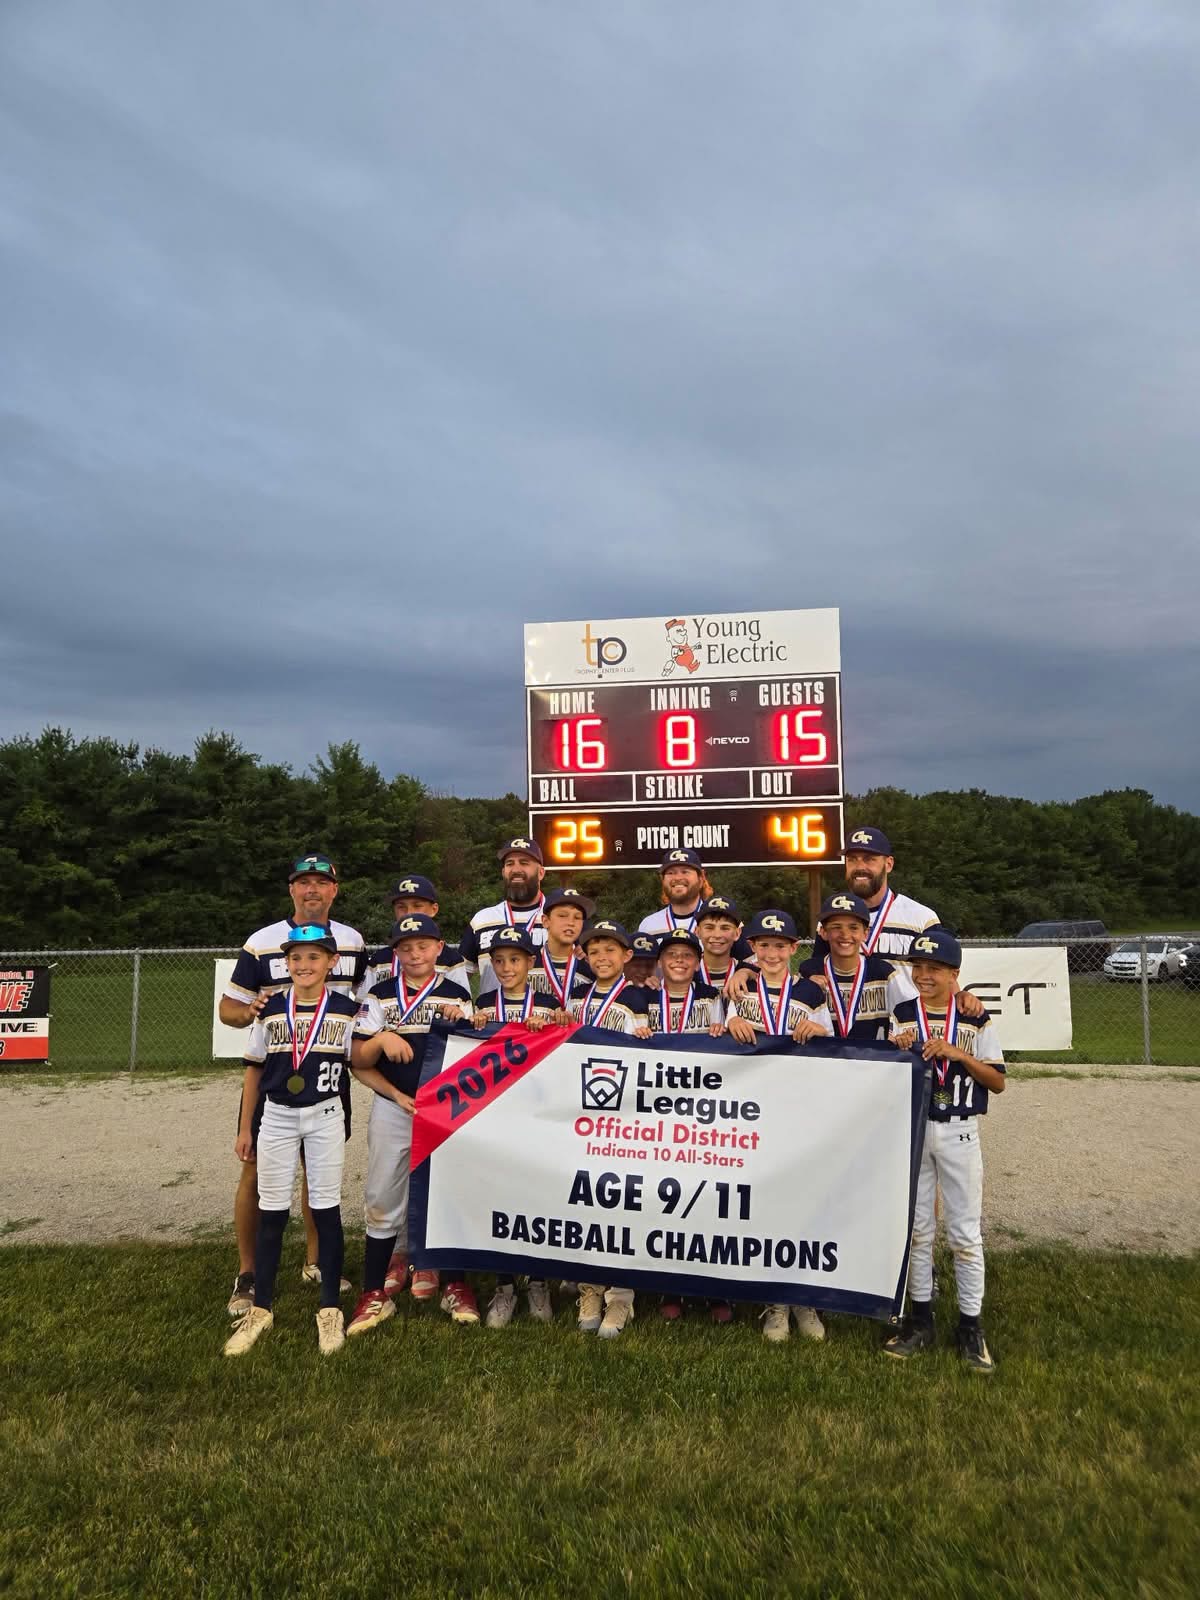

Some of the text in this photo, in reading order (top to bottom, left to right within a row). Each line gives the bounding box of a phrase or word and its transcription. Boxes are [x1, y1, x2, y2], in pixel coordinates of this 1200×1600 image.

[692, 617, 761, 641] Young
[706, 639, 787, 665] Electric
[550, 691, 595, 715] HOME
[650, 686, 711, 711] INNING
[758, 681, 825, 707] GUESTS
[560, 718, 606, 770] 16
[665, 714, 697, 768] 8
[779, 709, 827, 763] 15
[539, 778, 577, 802] BALL
[645, 774, 704, 799] STRIKE
[760, 772, 793, 796] OUT
[553, 820, 604, 860] 25
[637, 824, 730, 850] PITCH COUNT
[772, 813, 827, 855] 46
[316, 1061, 343, 1092] 28
[436, 1036, 529, 1121] 2026
[637, 1061, 723, 1090] Little
[636, 1089, 761, 1125] League
[574, 1115, 760, 1150] Official District
[586, 1142, 744, 1169] Indiana 10 All-Stars
[568, 1170, 751, 1221] AGE 9/11
[491, 1210, 838, 1272] BASEBALL CHAMPIONS
